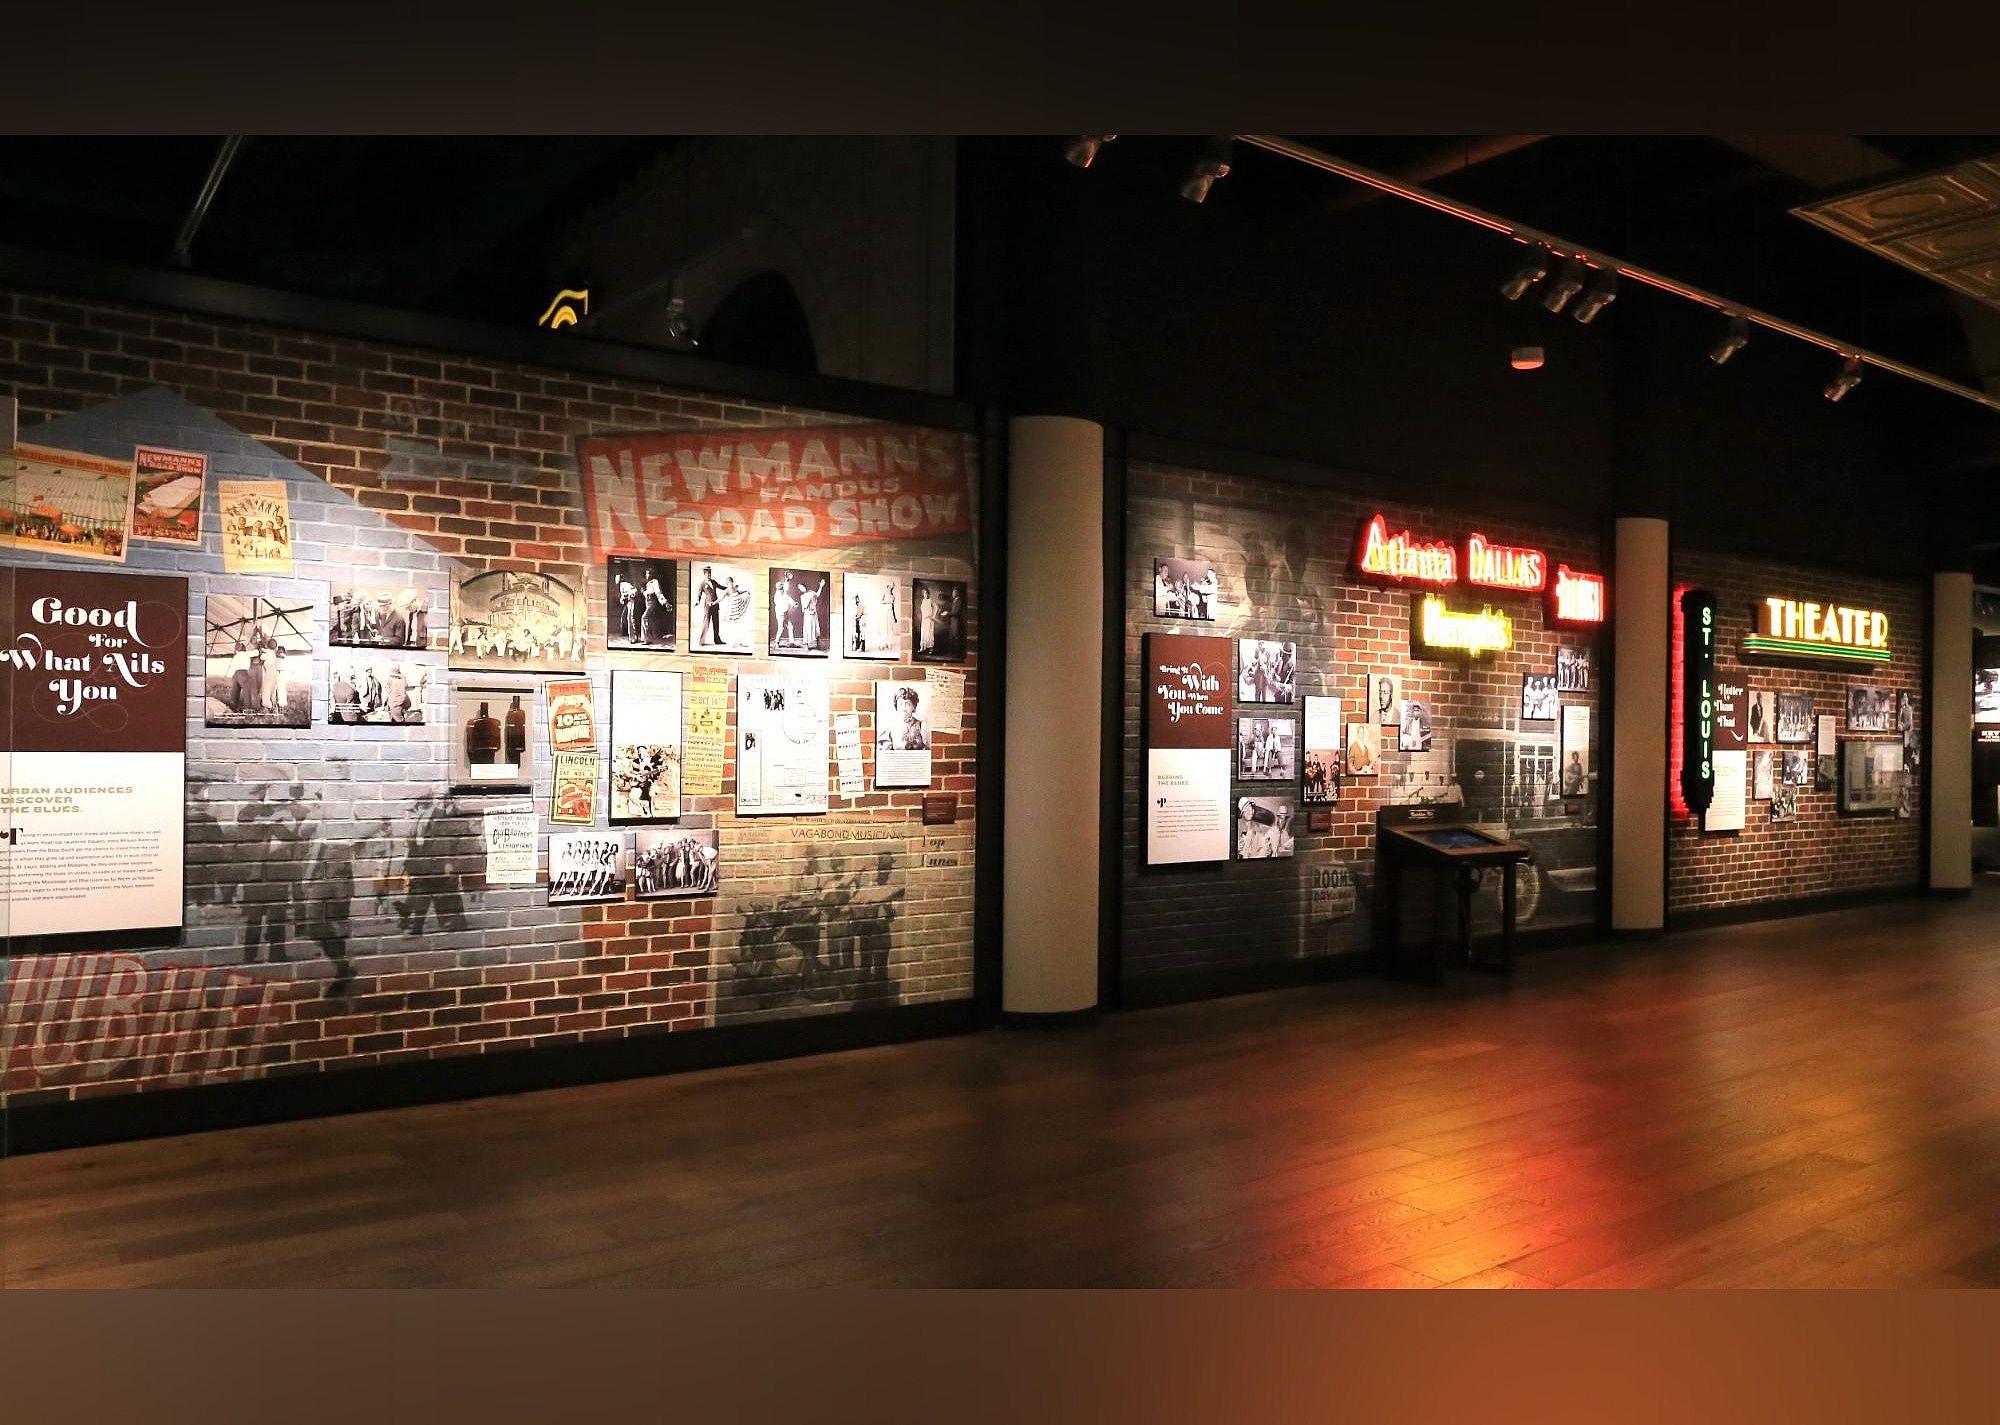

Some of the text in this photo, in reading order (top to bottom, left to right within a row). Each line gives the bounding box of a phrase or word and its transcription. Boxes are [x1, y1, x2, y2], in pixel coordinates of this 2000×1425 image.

[760, 477, 900, 503] FAMOUS
[666, 494, 959, 550] ROAD SHOW
[1361, 514, 1457, 584] Atlanta
[31, 597, 150, 648] Good
[1766, 598, 1889, 648] THEATER
[88, 633, 128, 648] For
[0, 632, 165, 687] What Ails
[1181, 662, 1220, 691] With
[48, 678, 118, 715] You
[1157, 685, 1209, 701] You When
[1713, 699, 1734, 712] Than
[1167, 701, 1224, 723] You Come
[1700, 680, 1711, 779] LOUIS
[560, 755, 596, 766] LINCOLN
[1, 786, 134, 795] URBAN AUDIENCES
[1, 796, 73, 804] DISCOVER
[791, 828, 905, 840] VAGABOND MUSICIANS
